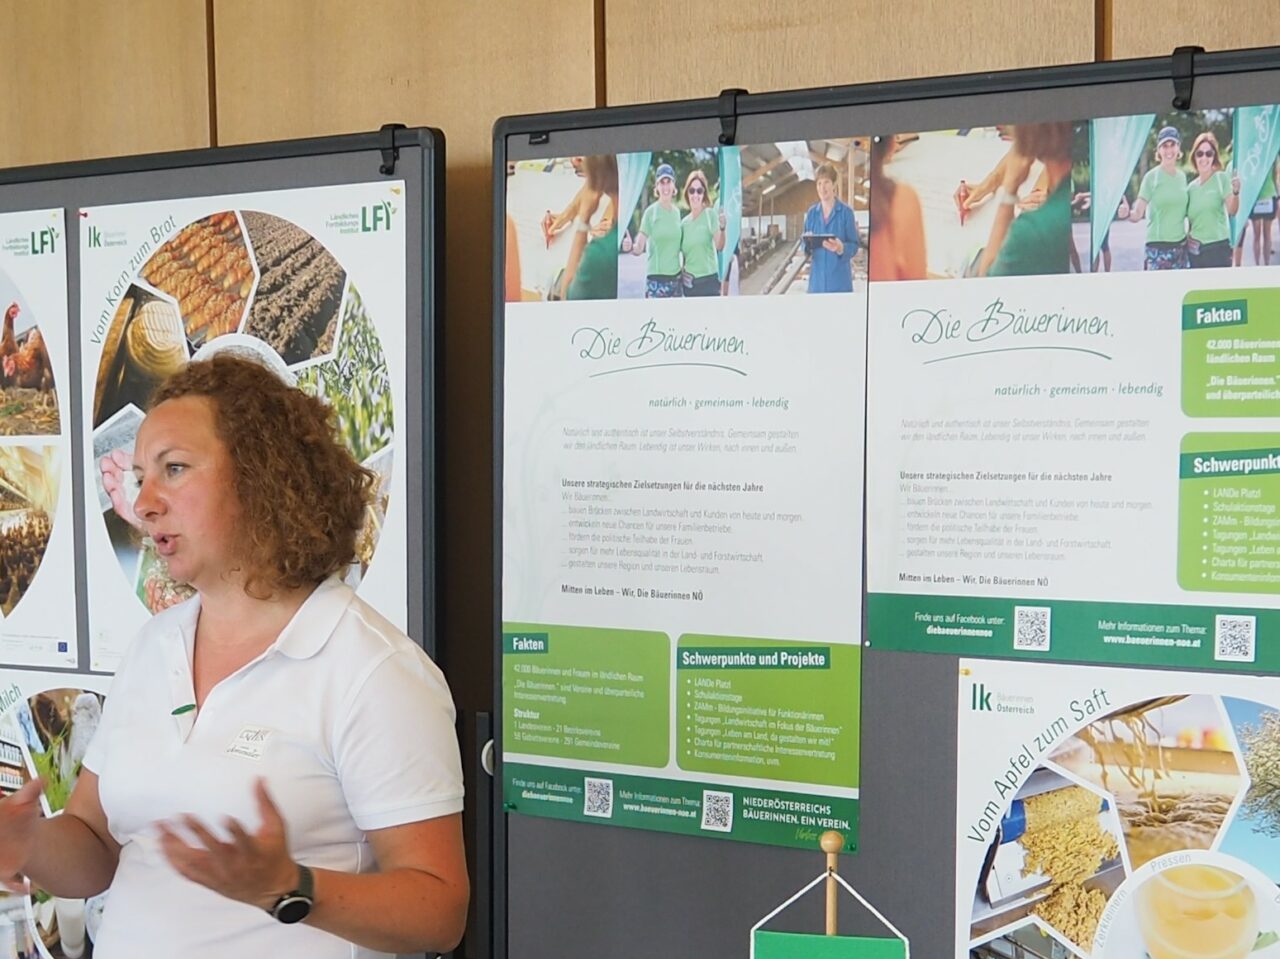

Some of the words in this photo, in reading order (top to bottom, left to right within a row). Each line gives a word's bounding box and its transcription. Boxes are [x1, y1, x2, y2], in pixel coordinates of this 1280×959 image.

[89, 309, 115, 346] Vom
[106, 268, 130, 309] Korn
[129, 242, 152, 272] zum
[151, 214, 178, 243] Brot
[901, 305, 961, 344] Die
[966, 296, 1114, 343] Bäuerinnen.
[1196, 307, 1242, 324] Fakten
[571, 327, 621, 359] Die
[624, 316, 749, 359] Bäuerinnen.
[994, 382, 1041, 396] natürlich
[1048, 385, 1108, 399] gemeinsam
[1118, 382, 1164, 398] lebendig
[649, 397, 687, 408] natürlich
[694, 399, 744, 410] gemeinsam
[751, 397, 789, 410] lebendig
[900, 471, 923, 480] Unsere
[926, 471, 974, 482] strategischen
[976, 472, 1026, 483] Zielsetzungen
[1028, 472, 1037, 481] für
[1040, 472, 1051, 481] die
[1054, 472, 1088, 481] nächsten
[1090, 473, 1113, 481] Jahre
[562, 479, 585, 488] Unsere
[587, 479, 632, 491] strategischen
[633, 480, 681, 492] Zielsetzungen
[683, 481, 692, 490] für
[694, 481, 705, 491] die
[707, 482, 740, 491] nächsten
[743, 482, 764, 492] Jahre
[898, 573, 921, 583] Mitten
[923, 574, 931, 583] im
[933, 574, 954, 584] Leben
[979, 575, 990, 584] Die
[993, 576, 1034, 586] Bäuerinnen
[1037, 577, 1049, 586] NÖ
[562, 584, 582, 594] Mitten
[584, 586, 592, 594] im
[594, 586, 614, 595] Leben
[637, 588, 648, 597] Die
[650, 589, 690, 599] Bäuerinnen
[692, 591, 703, 600] NÖ
[914, 612, 931, 622] Finde
[945, 613, 955, 623] auf
[956, 613, 985, 624] Facebook
[987, 615, 1006, 625] unter:
[1098, 620, 1115, 631] Mehr
[1117, 621, 1164, 632] Informationen
[1166, 625, 1180, 633] zum
[1182, 623, 1208, 634] Thema:
[513, 637, 544, 650] Fakten
[682, 651, 756, 668] Schwerpunkte
[759, 653, 778, 665] und
[780, 653, 825, 668] Projekte
[996, 702, 1035, 715] Österreich
[968, 804, 999, 844] Vom
[994, 744, 1036, 800] Apfel
[1033, 715, 1070, 752] zum
[1069, 688, 1111, 722] Saft
[743, 796, 831, 815] NIEDERÖSTERREICHS
[801, 816, 816, 826] EIN
[1150, 853, 1192, 872] Pressen
[1093, 888, 1128, 949] Zerkleinern
